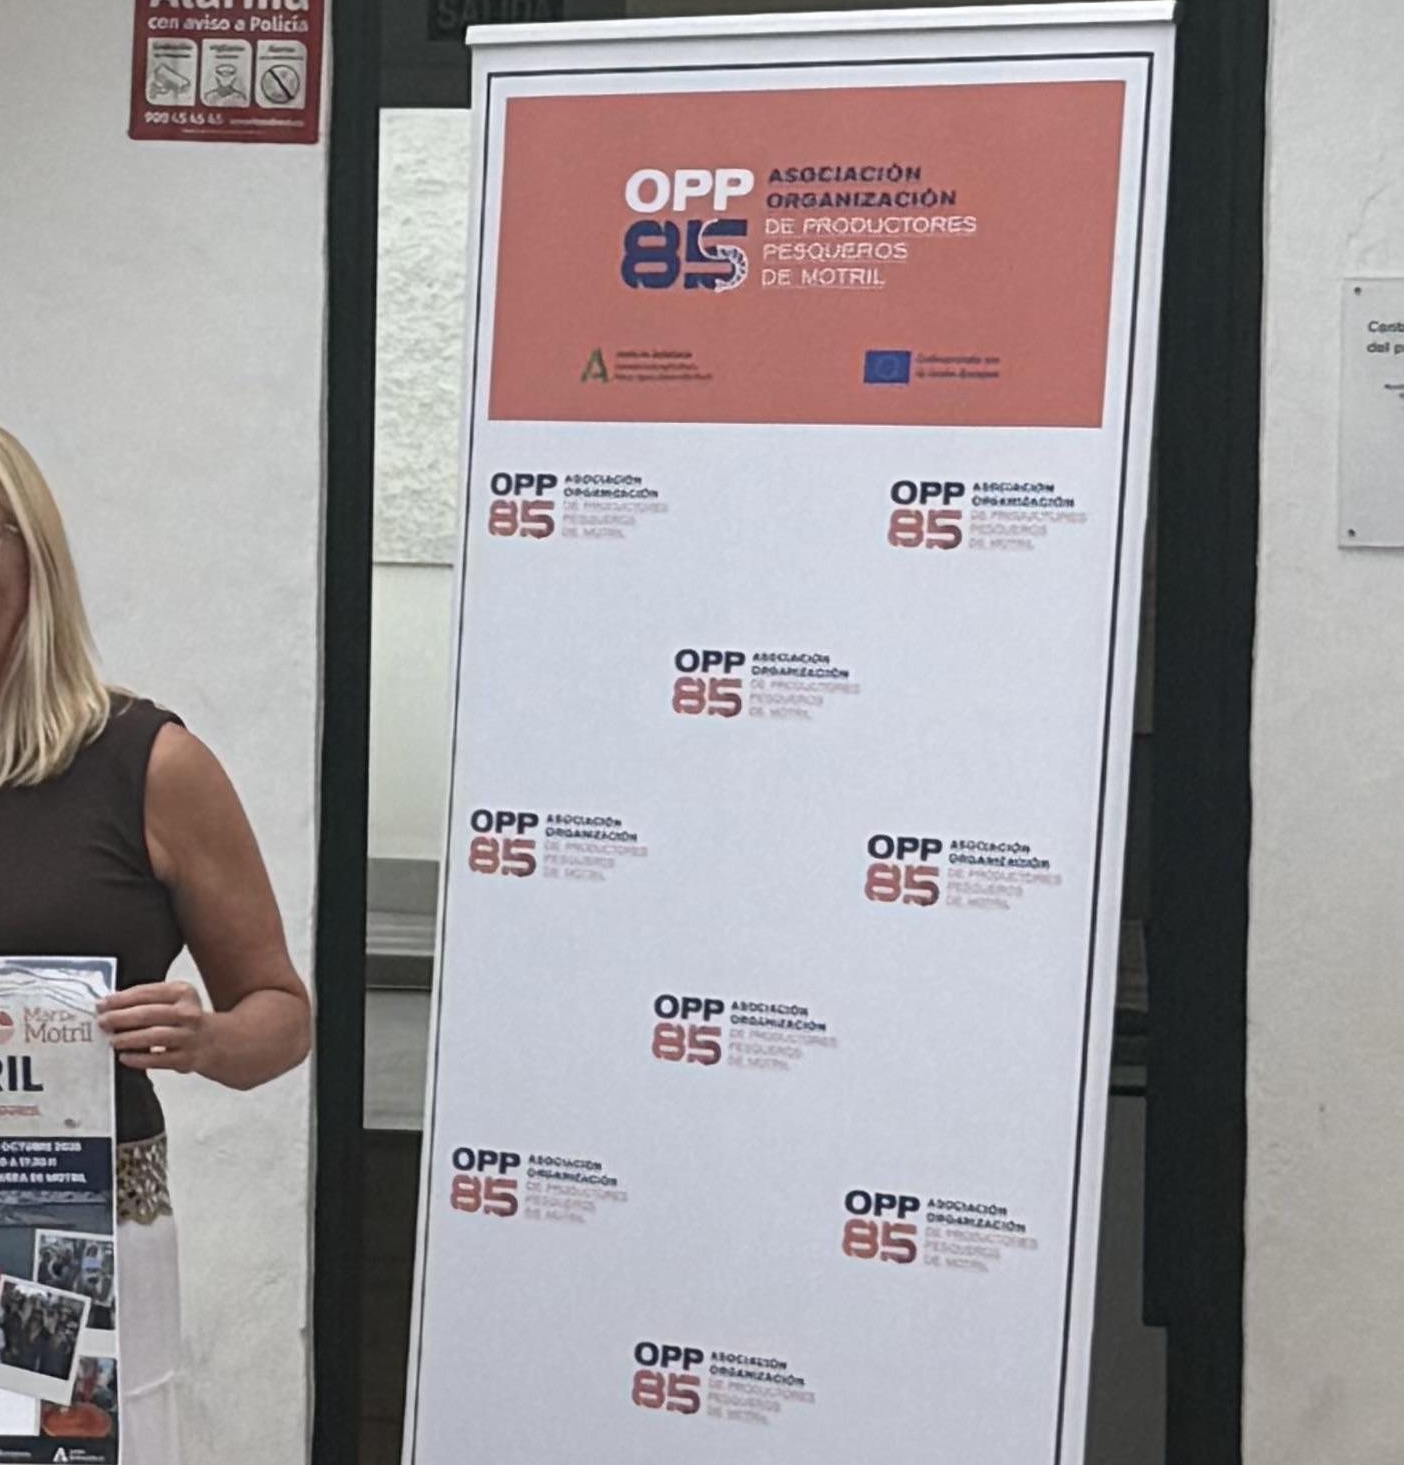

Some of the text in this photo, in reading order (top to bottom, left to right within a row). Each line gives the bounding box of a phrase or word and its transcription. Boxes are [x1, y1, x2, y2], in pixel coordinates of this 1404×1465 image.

[147, 14, 309, 33] con aviso a Policía
[769, 163, 922, 183] ASOCIACIÓN
[625, 168, 755, 213] OPP
[766, 188, 956, 209] ORGANIZACIÓN
[765, 216, 977, 235] DE PRODUCTORES
[621, 218, 749, 295] 85
[763, 242, 908, 261] PESQUEROS
[761, 268, 885, 287] DE MOTRIL
[1367, 320, 1404, 333] Cent
[490, 473, 557, 496] OPP
[891, 480, 965, 505] OPP
[488, 500, 554, 539] 85
[888, 509, 962, 549] 85
[675, 649, 745, 673] OPP
[672, 677, 742, 717] 85
[471, 809, 539, 834] OPP
[469, 837, 536, 877] 85
[868, 834, 942, 861] OPP
[865, 863, 939, 906] 85
[654, 994, 724, 1021] OPP
[24, 1021, 93, 1044] Motril
[652, 1023, 721, 1066] 85
[452, 1147, 520, 1174] OPP
[451, 1175, 518, 1217] 85
[845, 1190, 920, 1219] OPP
[843, 1219, 917, 1264] 85
[634, 1342, 704, 1371] OPP
[632, 1369, 700, 1414] 85
